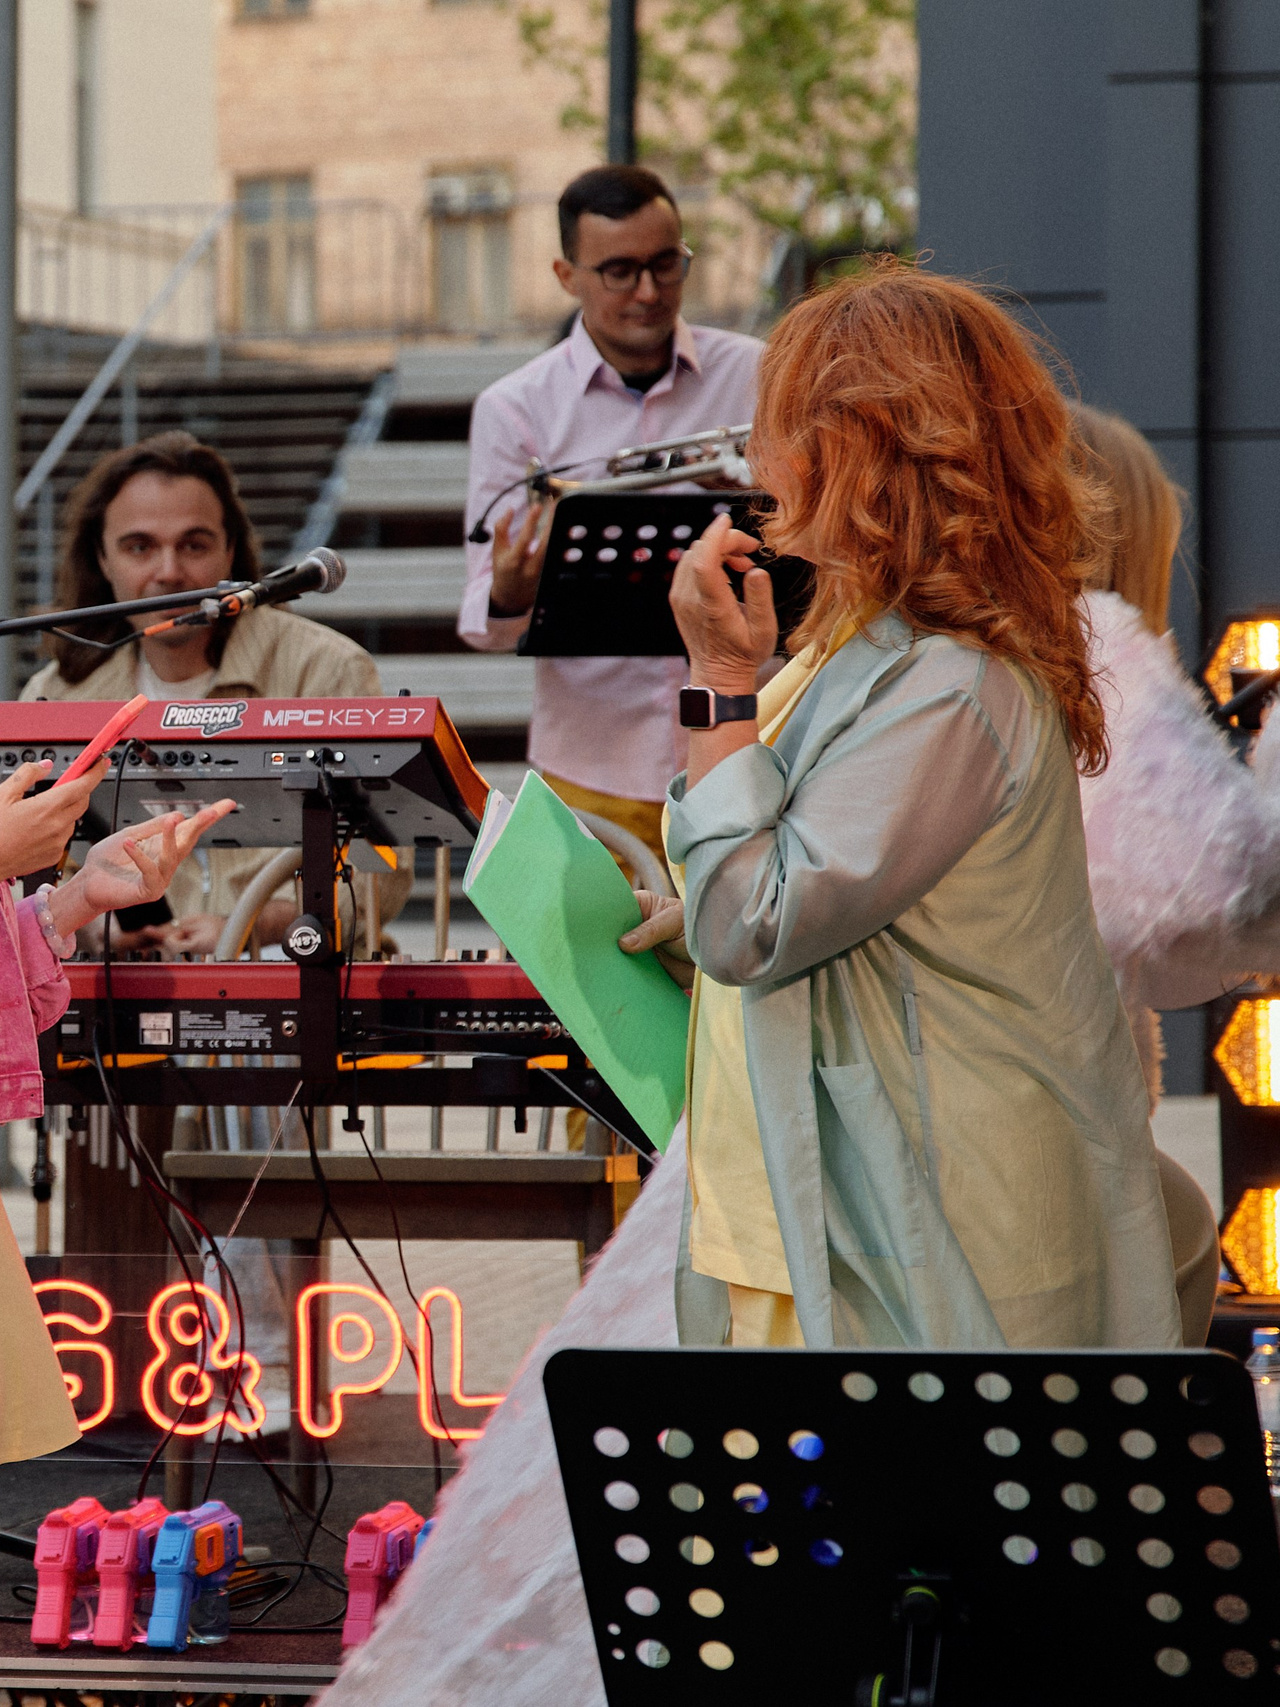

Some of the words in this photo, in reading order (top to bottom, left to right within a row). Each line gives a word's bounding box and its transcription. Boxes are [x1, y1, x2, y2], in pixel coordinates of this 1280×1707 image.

[165, 706, 238, 725] PROSECCO
[263, 709, 324, 727] MPC
[328, 709, 384, 726] KEY
[388, 708, 426, 726] 37
